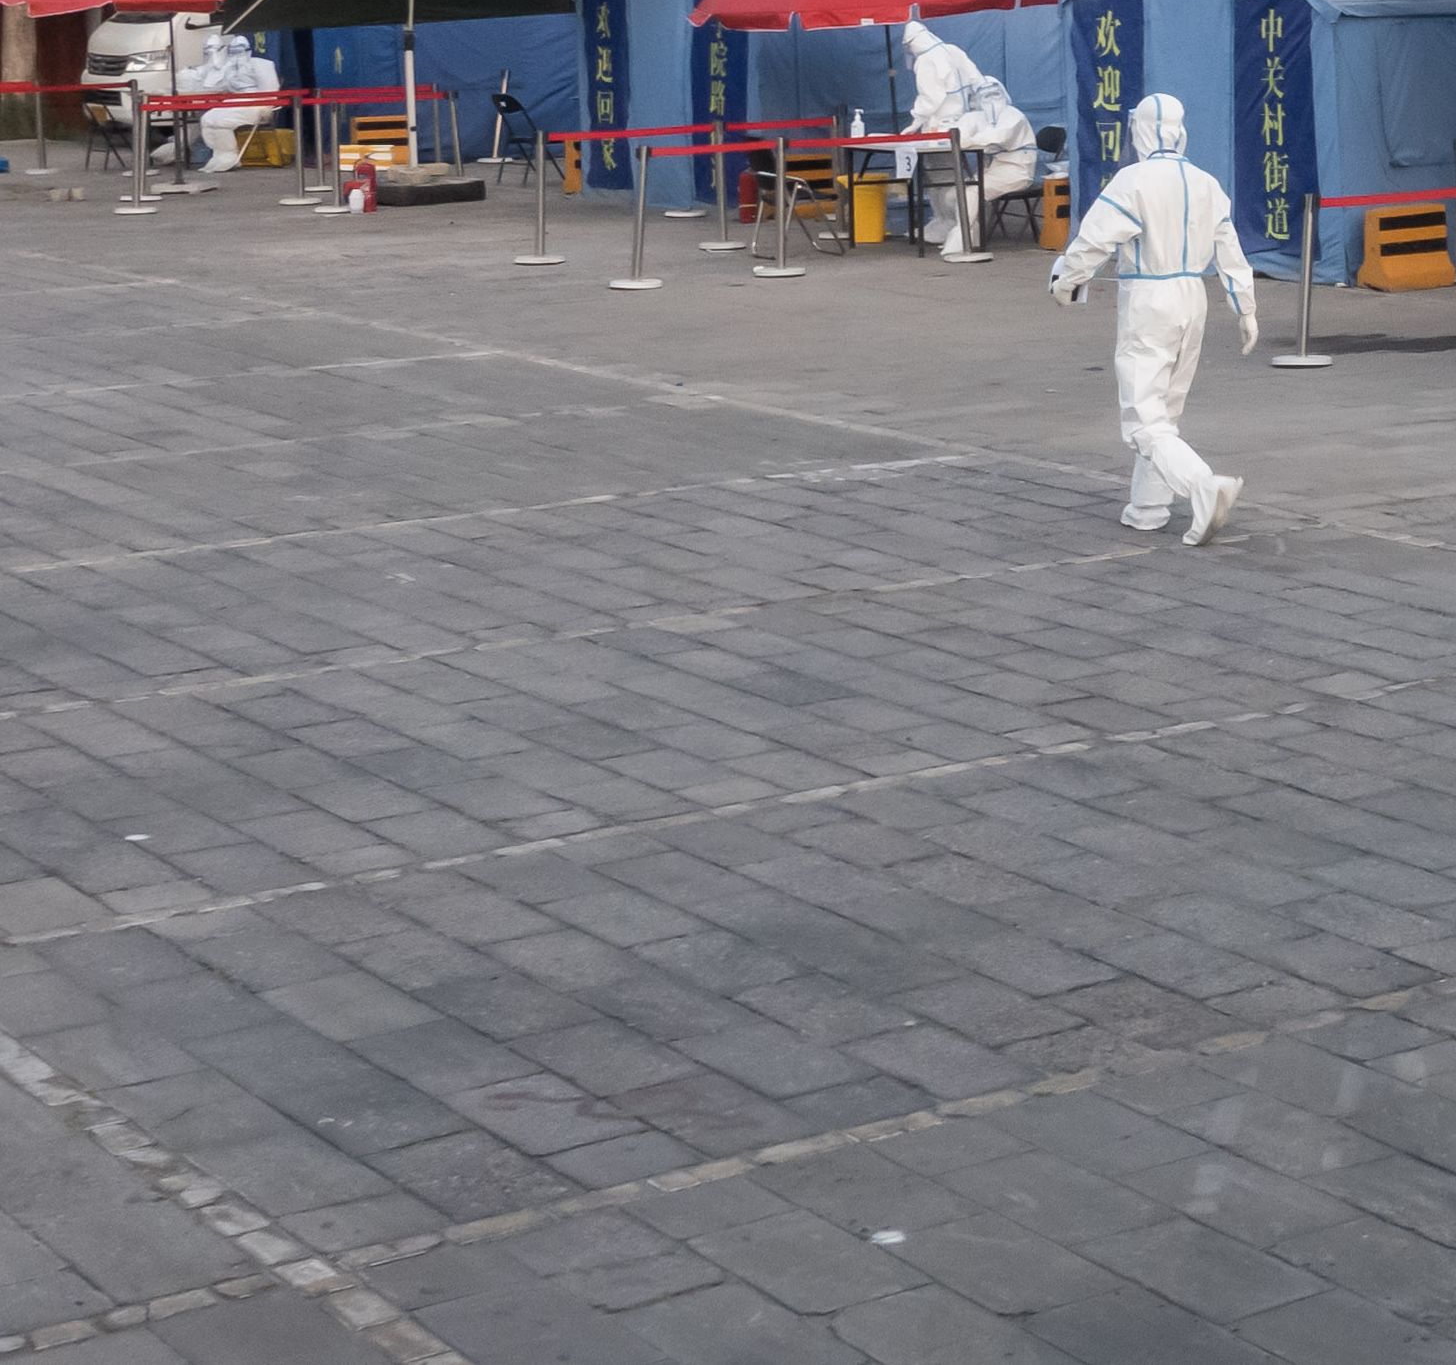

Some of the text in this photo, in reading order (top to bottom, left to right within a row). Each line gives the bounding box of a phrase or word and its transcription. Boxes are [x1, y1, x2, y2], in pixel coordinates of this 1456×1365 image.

[905, 155, 913, 172] 3
[1093, 10, 1122, 188] 欢迎回
[1260, 9, 1290, 241] 中关村街道
